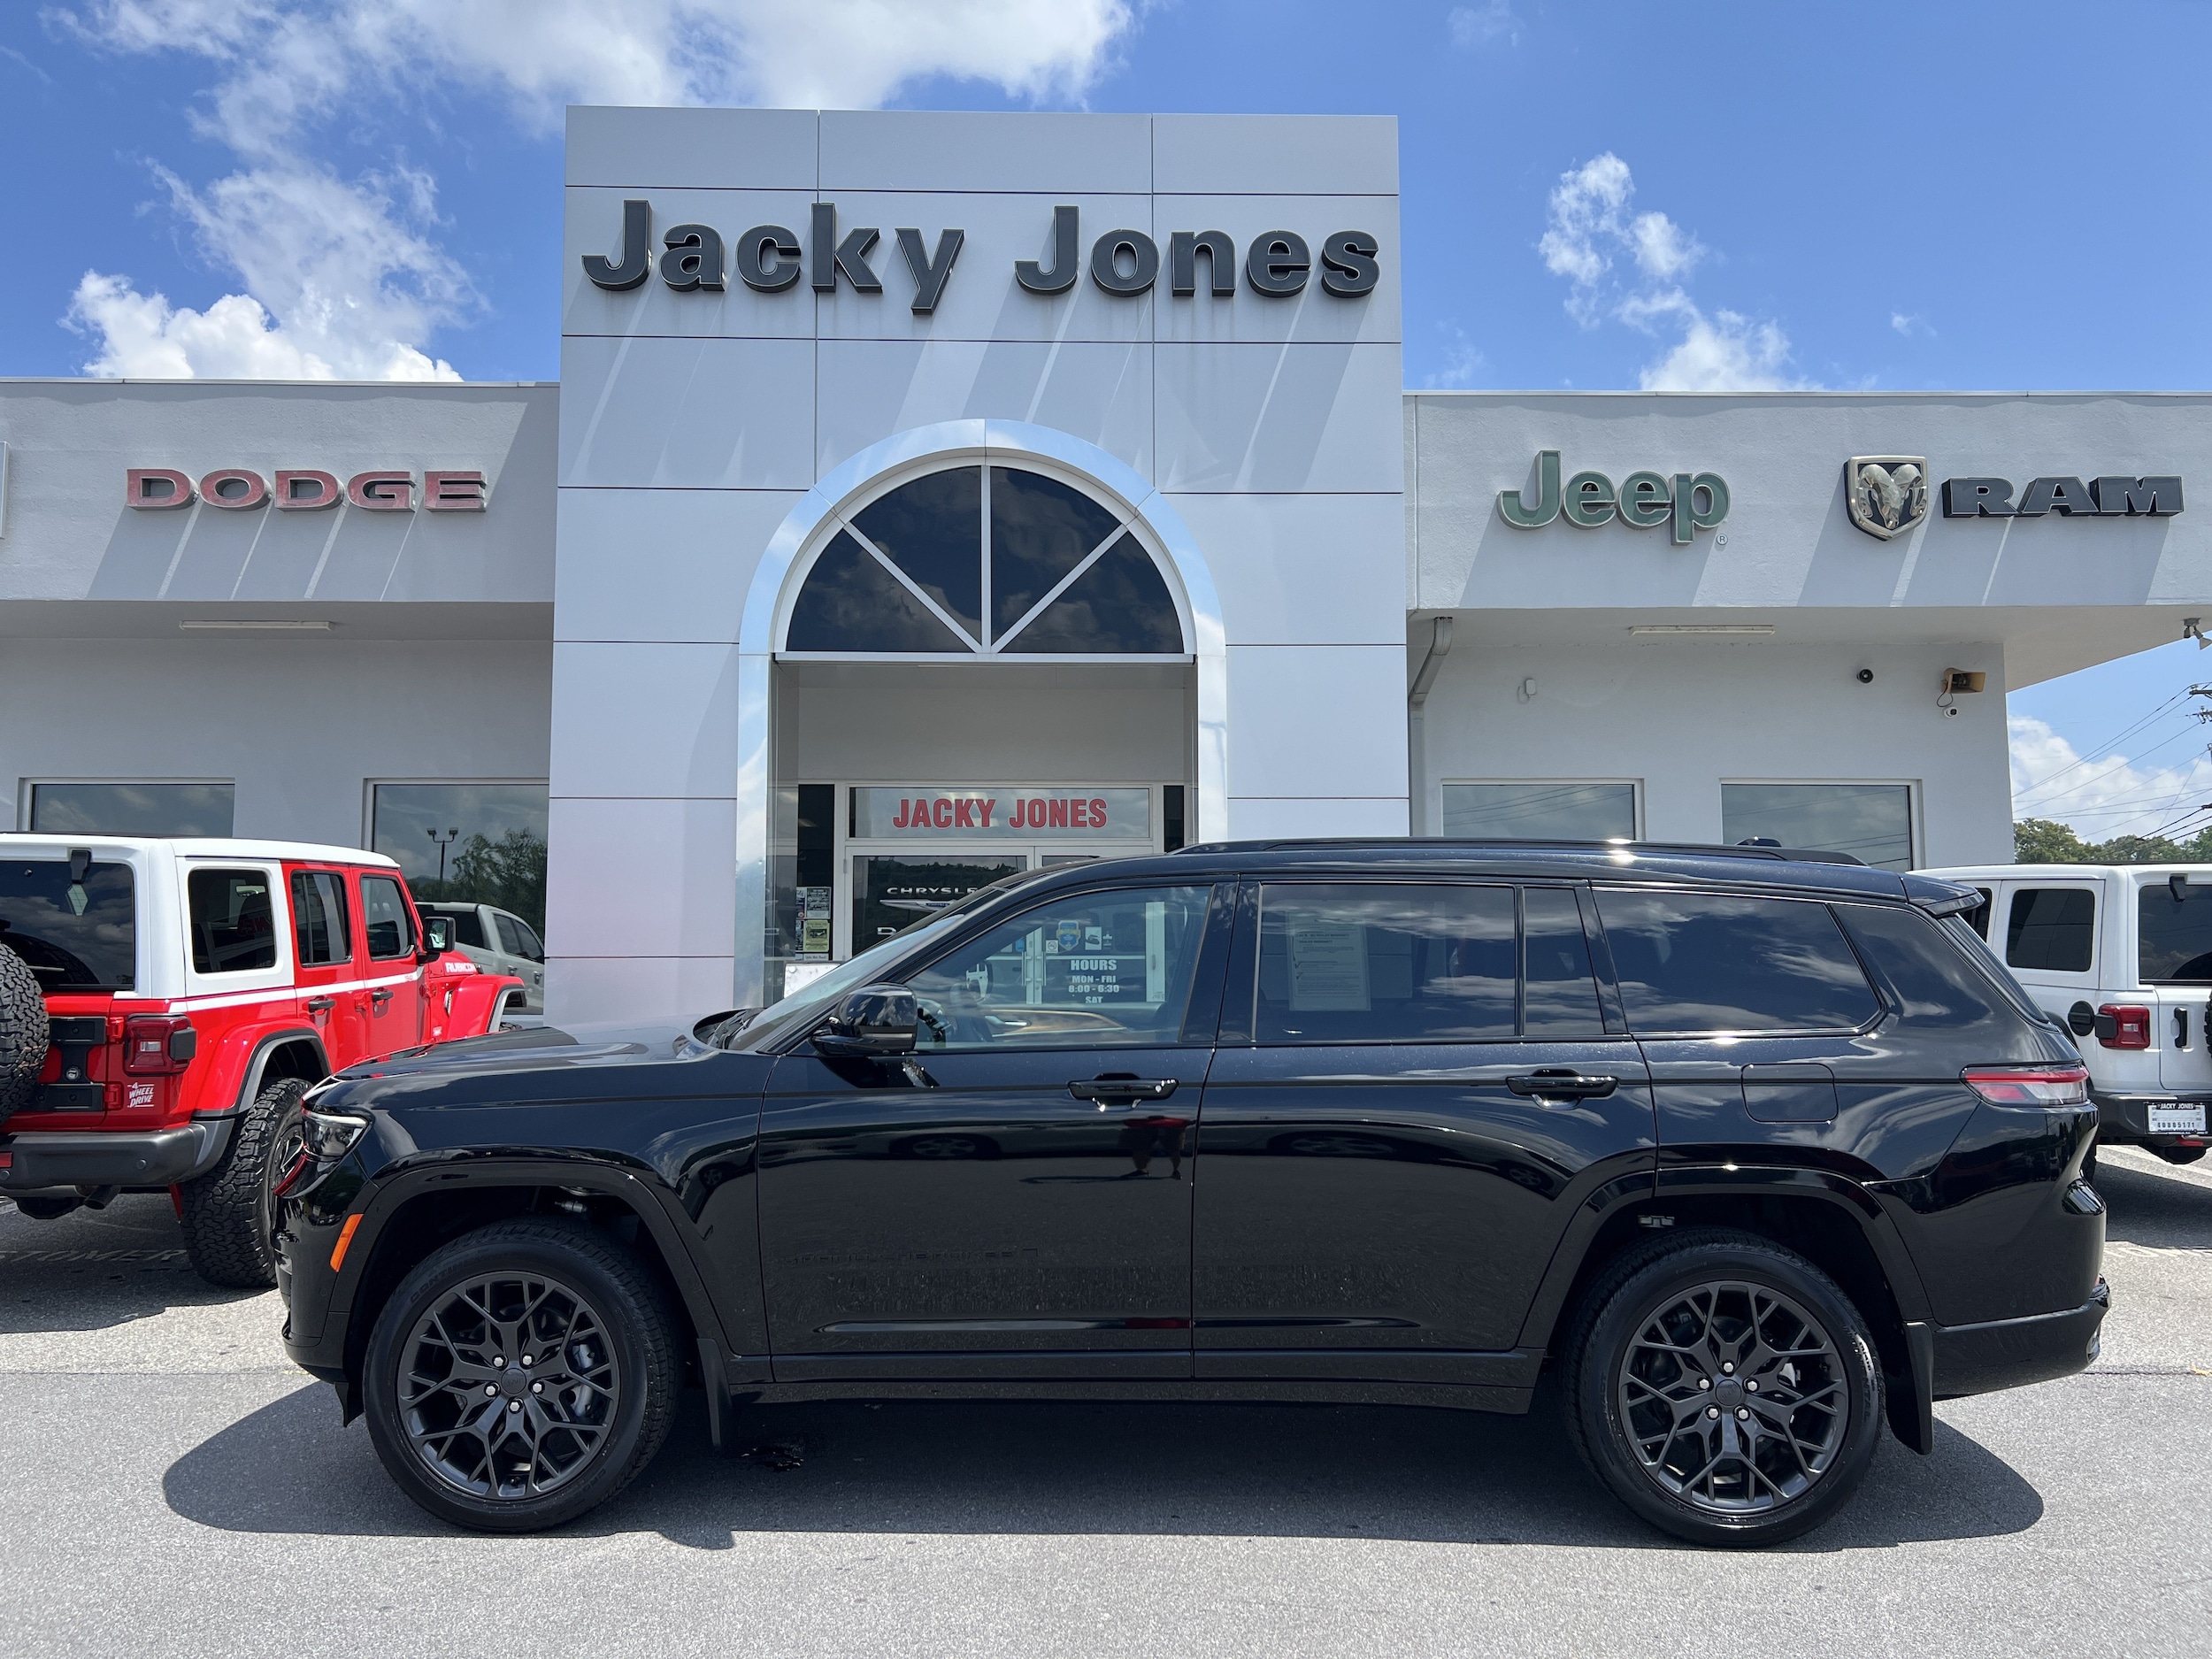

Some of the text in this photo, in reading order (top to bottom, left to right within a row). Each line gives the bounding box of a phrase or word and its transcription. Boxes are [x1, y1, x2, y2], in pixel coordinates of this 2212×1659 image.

[581, 199, 1380, 316] Jacky Jones
[127, 468, 488, 513] DODGE
[1942, 475, 2185, 518] RAM
[1497, 449, 1731, 547] Jeep
[892, 797, 1108, 829] JACKY JONES
[887, 887, 979, 895] CHRYSLE
[444, 962, 477, 973] RUBICON
[1070, 959, 1118, 972] HOURS
[1071, 975, 1094, 984] MON
[1101, 975, 1117, 984] FRI
[1068, 984, 1091, 993] 8:00
[1097, 984, 1120, 993] 6:30
[1085, 995, 1103, 1004] SAT
[129, 1087, 154, 1099] WHEEL
[130, 1094, 153, 1108] DRIVE
[0, 1249, 188, 1262] TOMER
